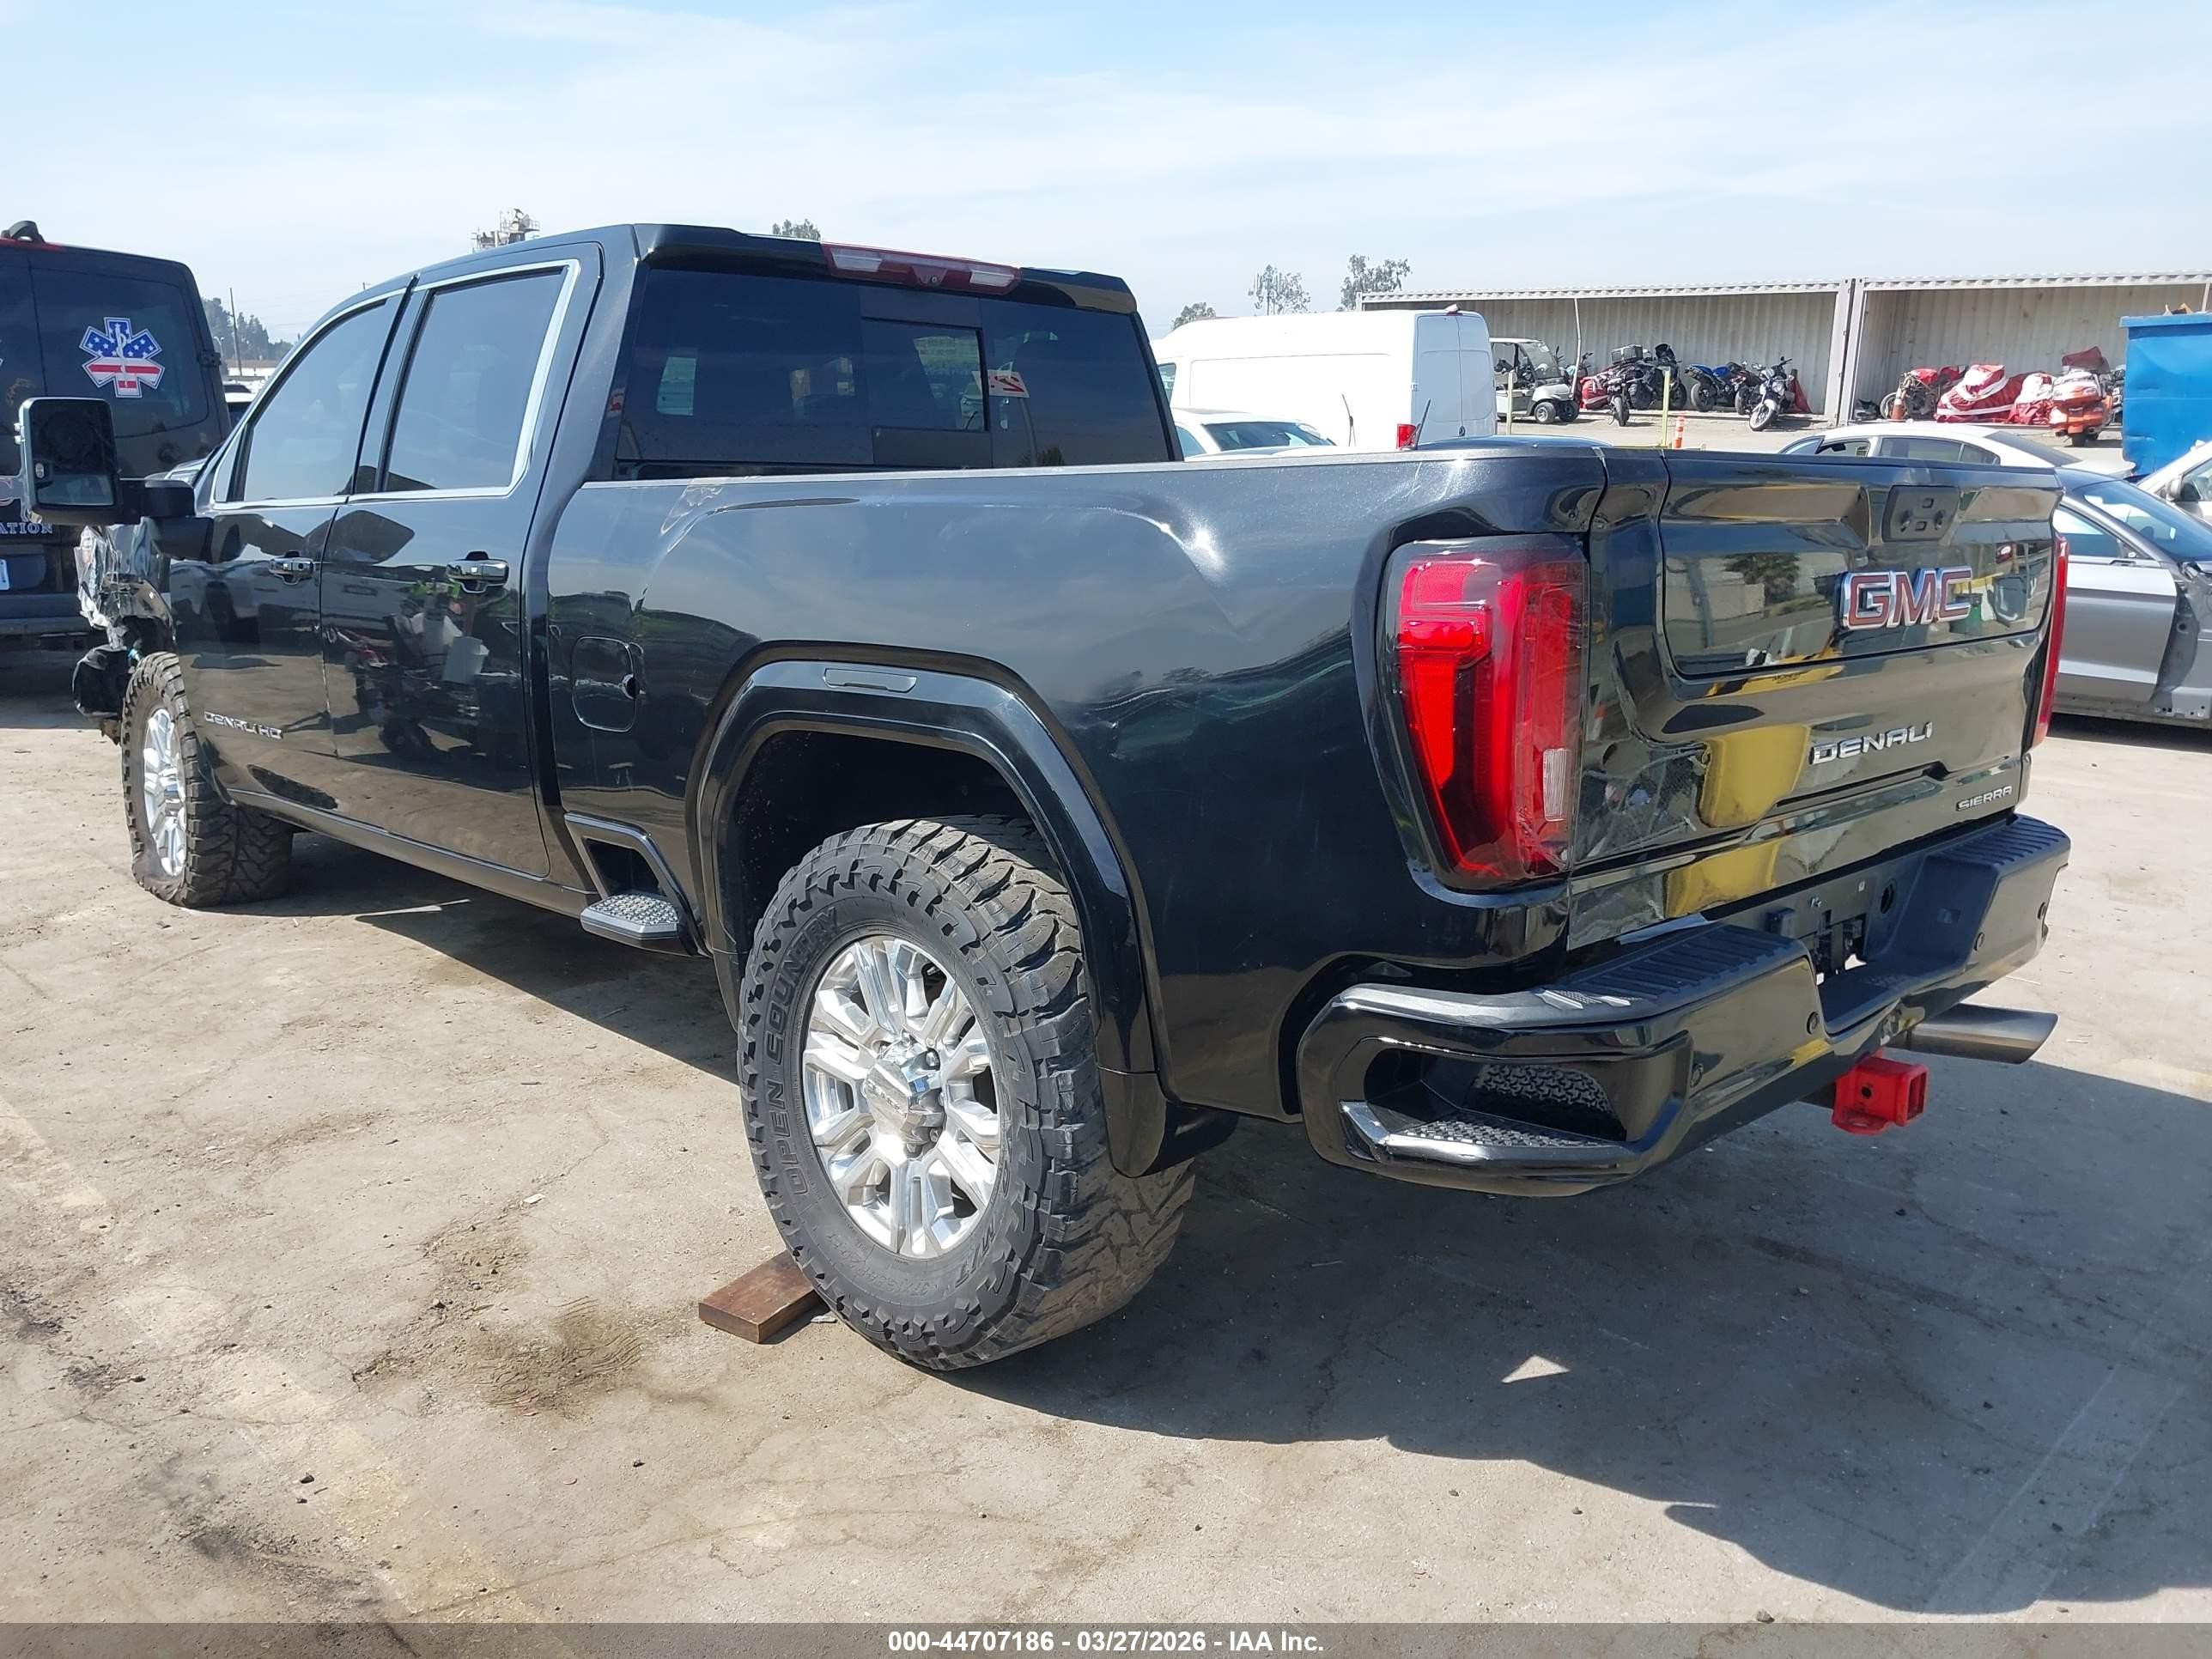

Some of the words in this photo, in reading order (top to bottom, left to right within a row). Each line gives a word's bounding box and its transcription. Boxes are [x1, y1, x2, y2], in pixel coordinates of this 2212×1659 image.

[1840, 567, 1972, 629] GMC
[1810, 721, 1933, 765] DENALI
[1955, 785, 2013, 811] SIERRA
[763, 905, 839, 1066] COUNTRY
[765, 1078, 810, 1196] OPEN
